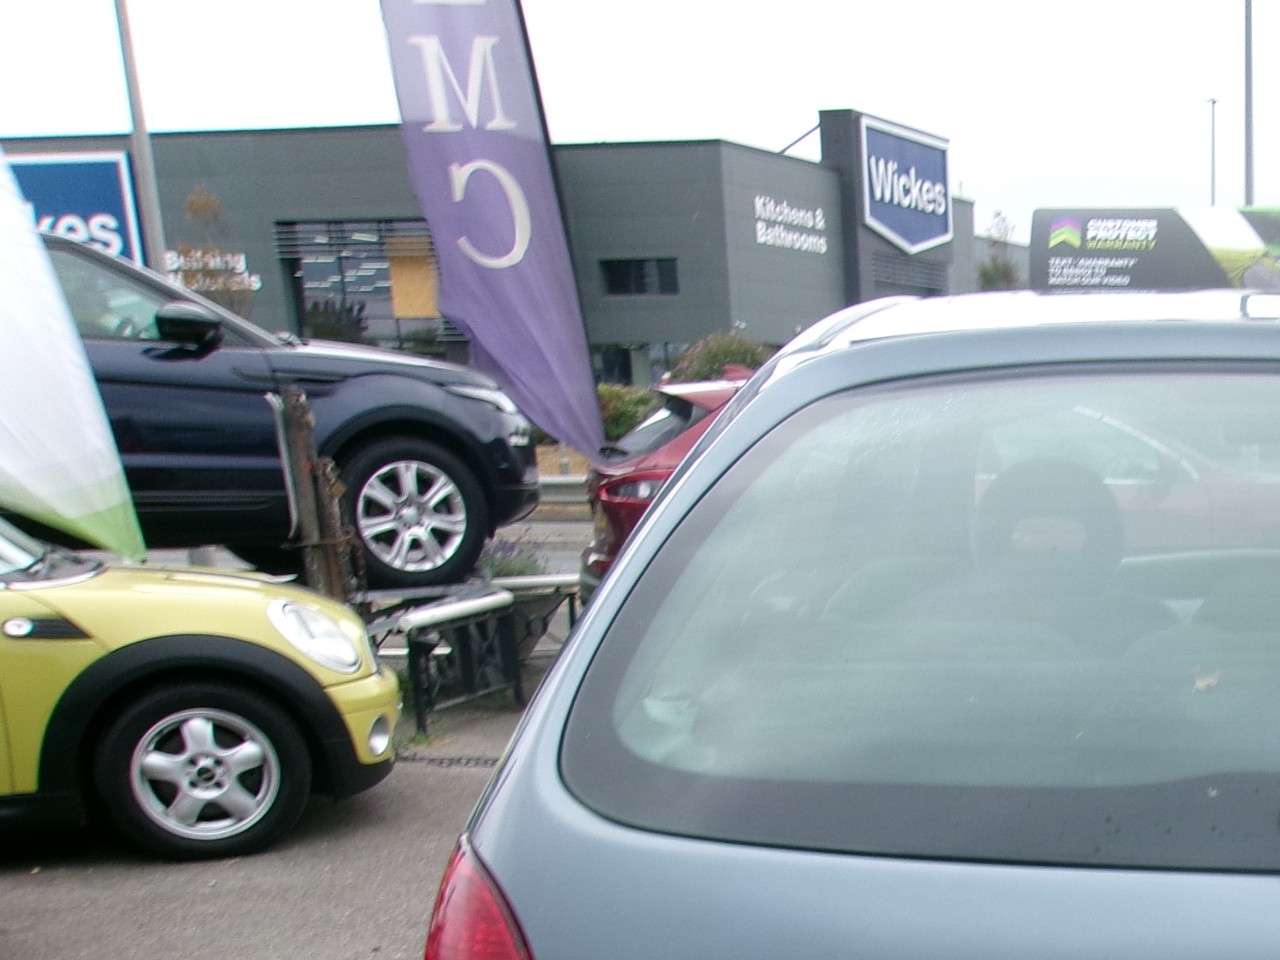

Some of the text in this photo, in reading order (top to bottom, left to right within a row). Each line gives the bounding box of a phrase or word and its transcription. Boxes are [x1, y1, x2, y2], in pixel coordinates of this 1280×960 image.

[869, 155, 946, 216] Wickes
[755, 194, 813, 228] Kitchens
[756, 220, 828, 255] Bathrooms
